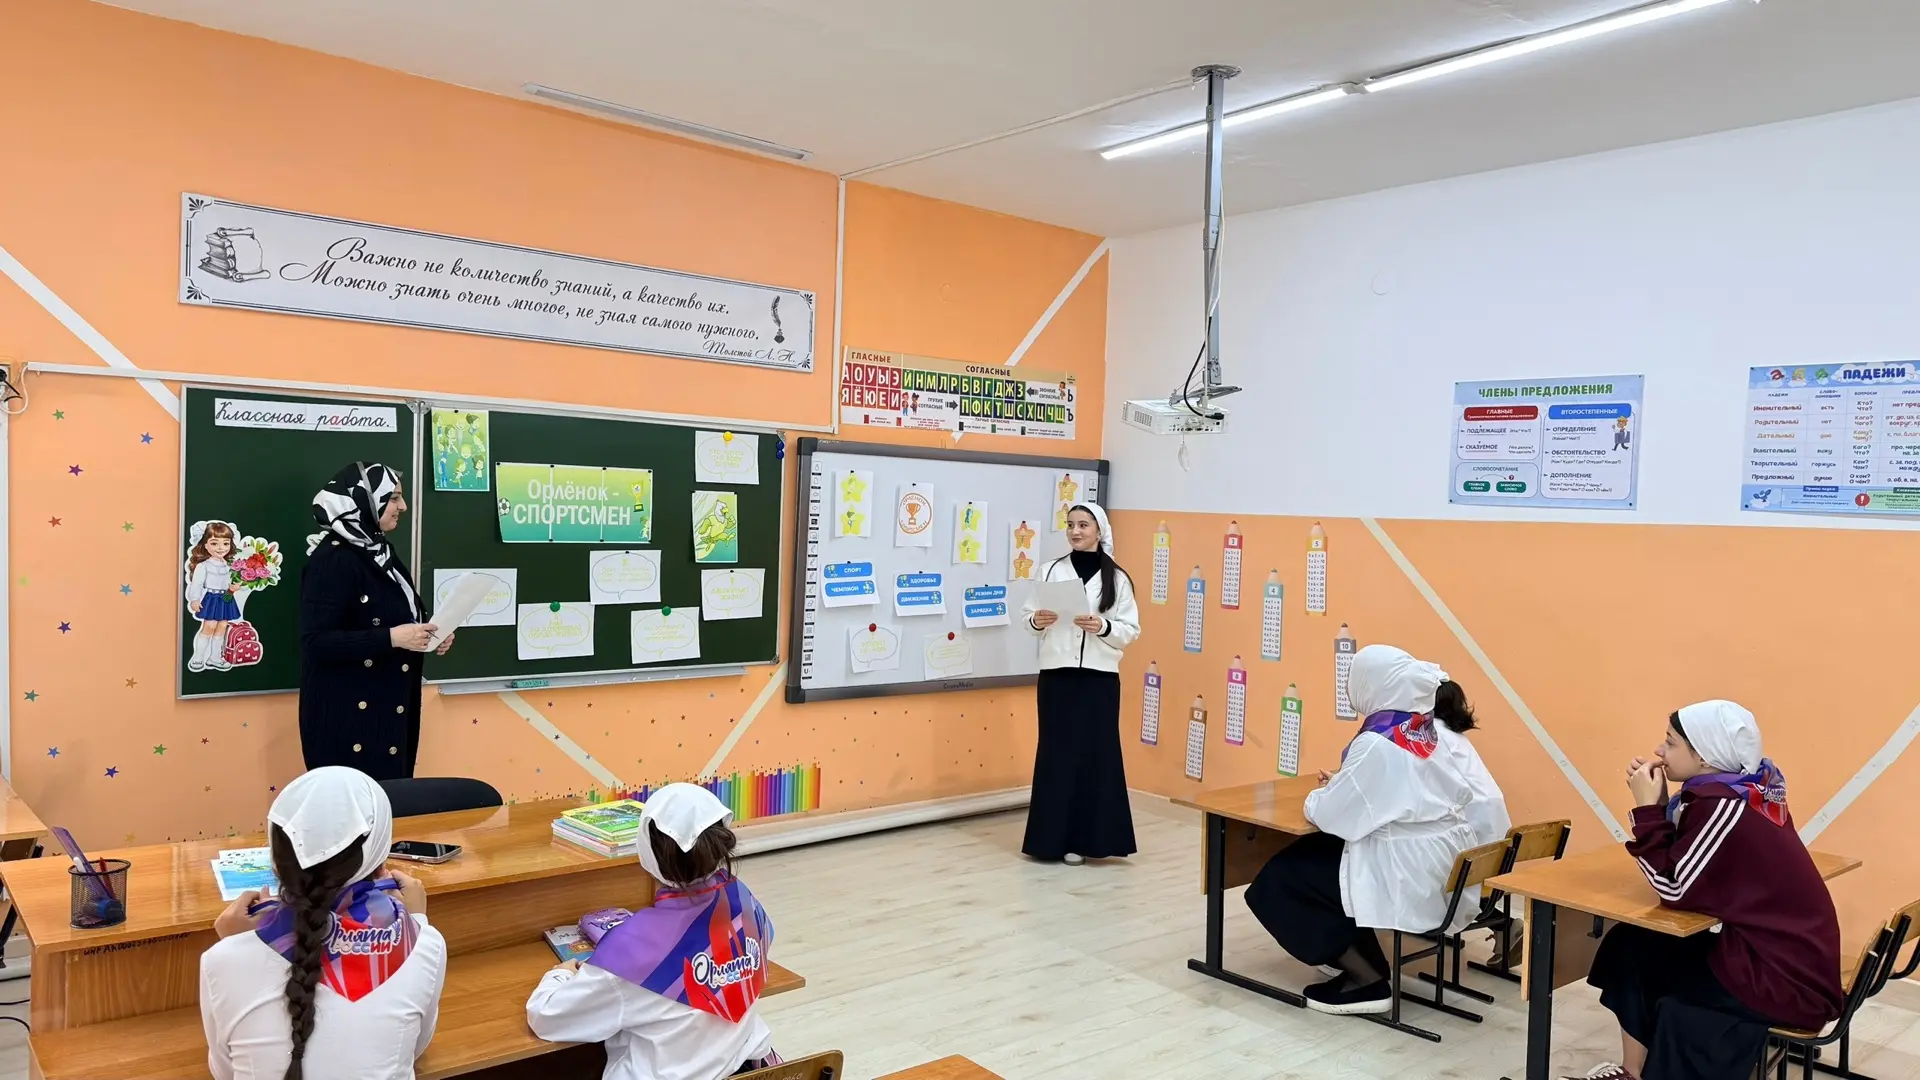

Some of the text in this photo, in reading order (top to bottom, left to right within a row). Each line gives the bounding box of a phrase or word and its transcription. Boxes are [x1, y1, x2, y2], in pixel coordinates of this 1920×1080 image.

[327, 237, 729, 315] Важно не количество знаний, а качество их.
[280, 260, 759, 342] Можно знать очень многое, не зная самого нужного.
[703, 339, 795, 363] Толстой Л. Н.
[851, 352, 891, 363] ГЛАСНЫЕ
[842, 363, 899, 385] А О У Ы Э
[966, 365, 1010, 376] СОГЛАСНЫЕ
[1843, 368, 1905, 379] ПАДЕЖИ
[904, 371, 1023, 397] Й Н М Л Р Б В Г Д Ж З
[1068, 389, 1073, 402] Ь
[1479, 384, 1613, 398] ЧЛЕНЫ ПРЕДЛОЖЕНИЯ
[842, 386, 899, 407] Я Ё Ю Е И
[215, 401, 390, 430] Классная работа.
[962, 399, 1065, 423] П Ф К Т Ш С Х Ц Ч Щ
[1066, 408, 1073, 421] Ъ
[528, 479, 608, 503] Орлёнок
[514, 503, 631, 526] СПОРТСМЕН
[694, 954, 751, 985] Орлята
